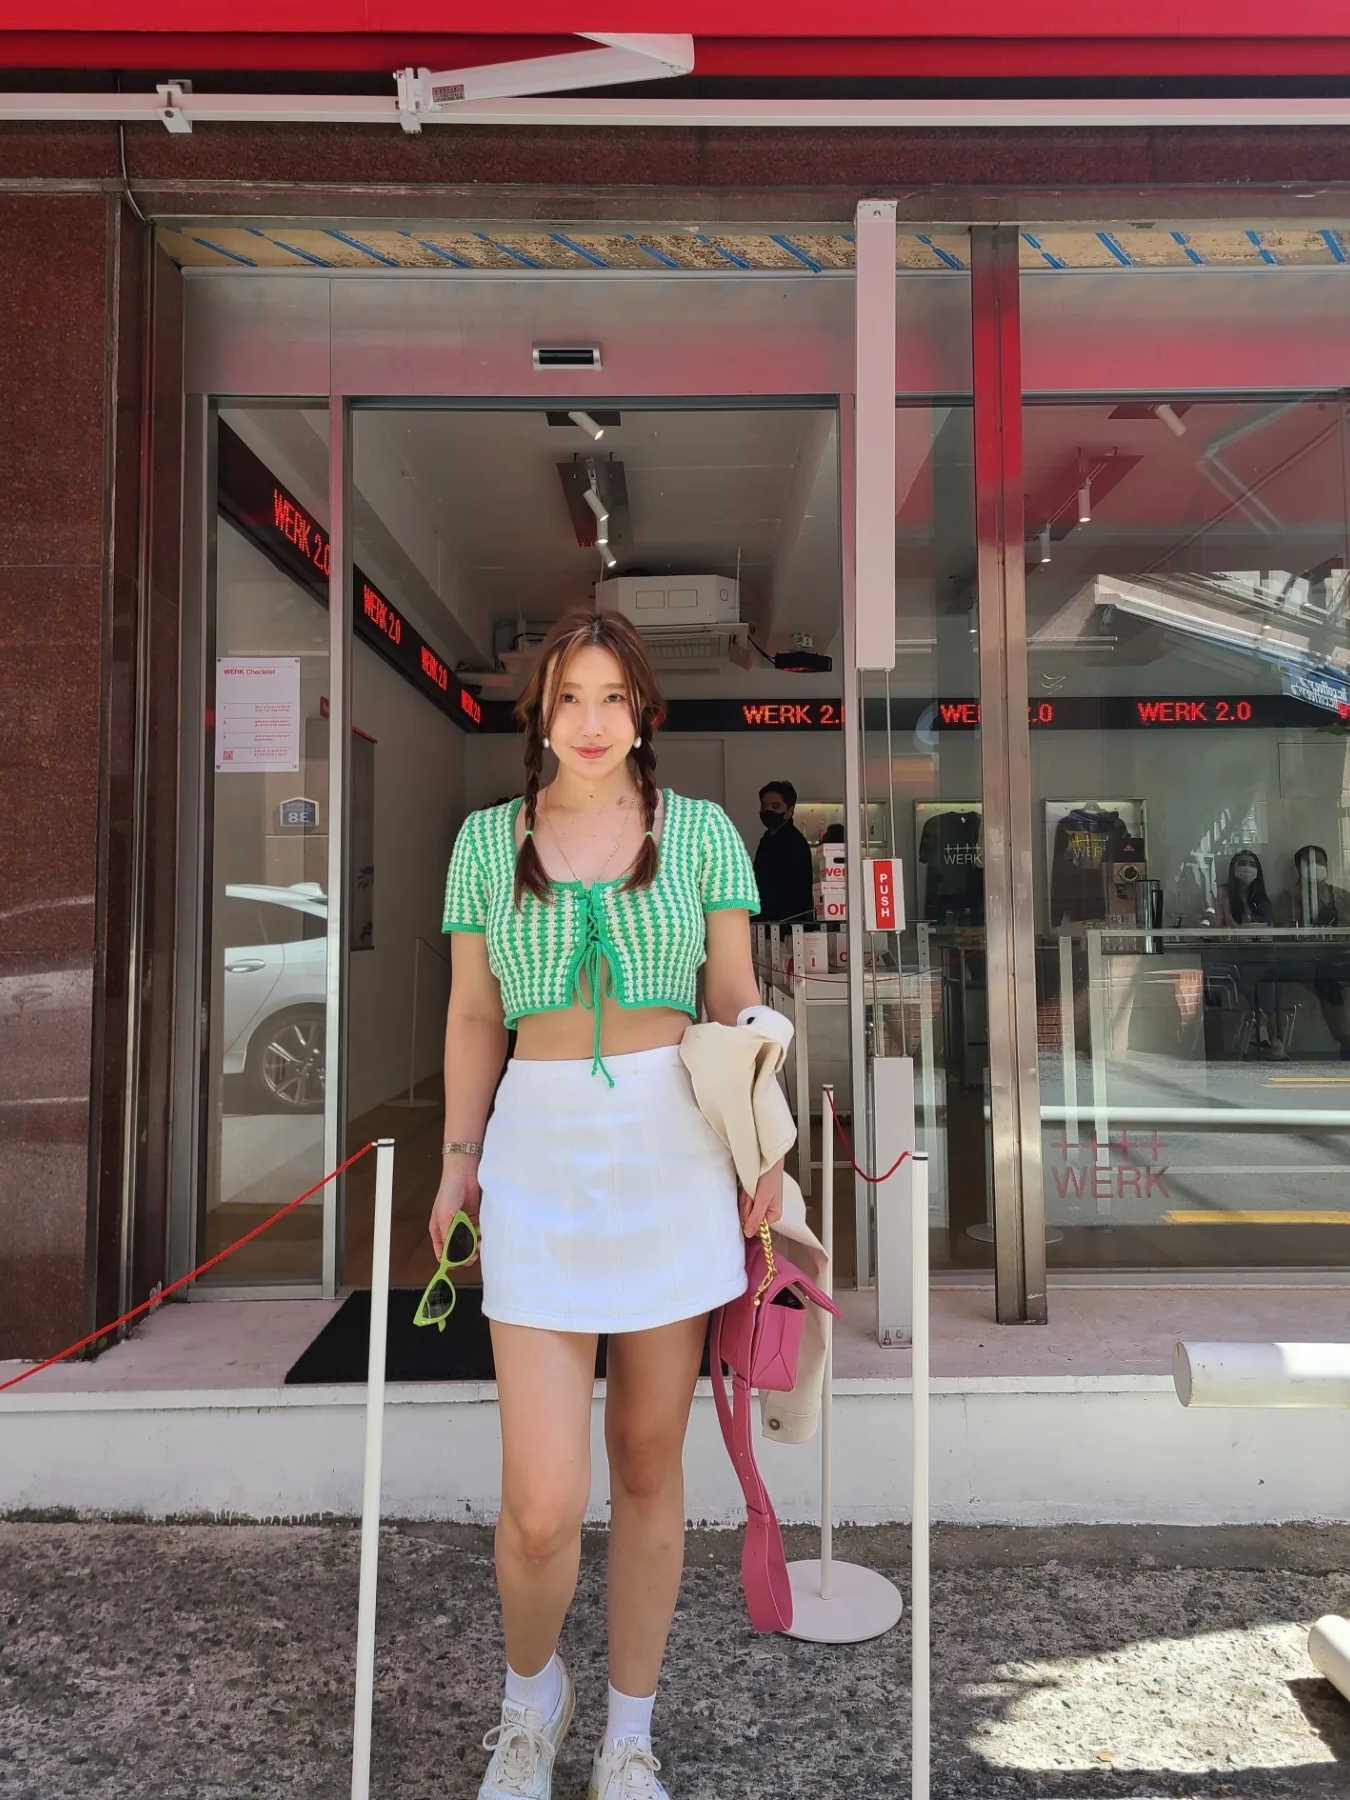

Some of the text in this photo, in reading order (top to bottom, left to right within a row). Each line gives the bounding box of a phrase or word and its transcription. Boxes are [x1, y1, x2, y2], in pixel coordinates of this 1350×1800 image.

[275, 489, 311, 558] WERK
[364, 584, 388, 633] WERK
[421, 645, 439, 683] WERK
[742, 705, 812, 724] WERK
[940, 704, 981, 723] WE
[1138, 701, 1252, 721] WERK 2.0
[943, 853, 982, 865] WERK
[1073, 845, 1105, 859] WER
[879, 873, 890, 918] PUSH
[1051, 1165, 1171, 1199] WERK
